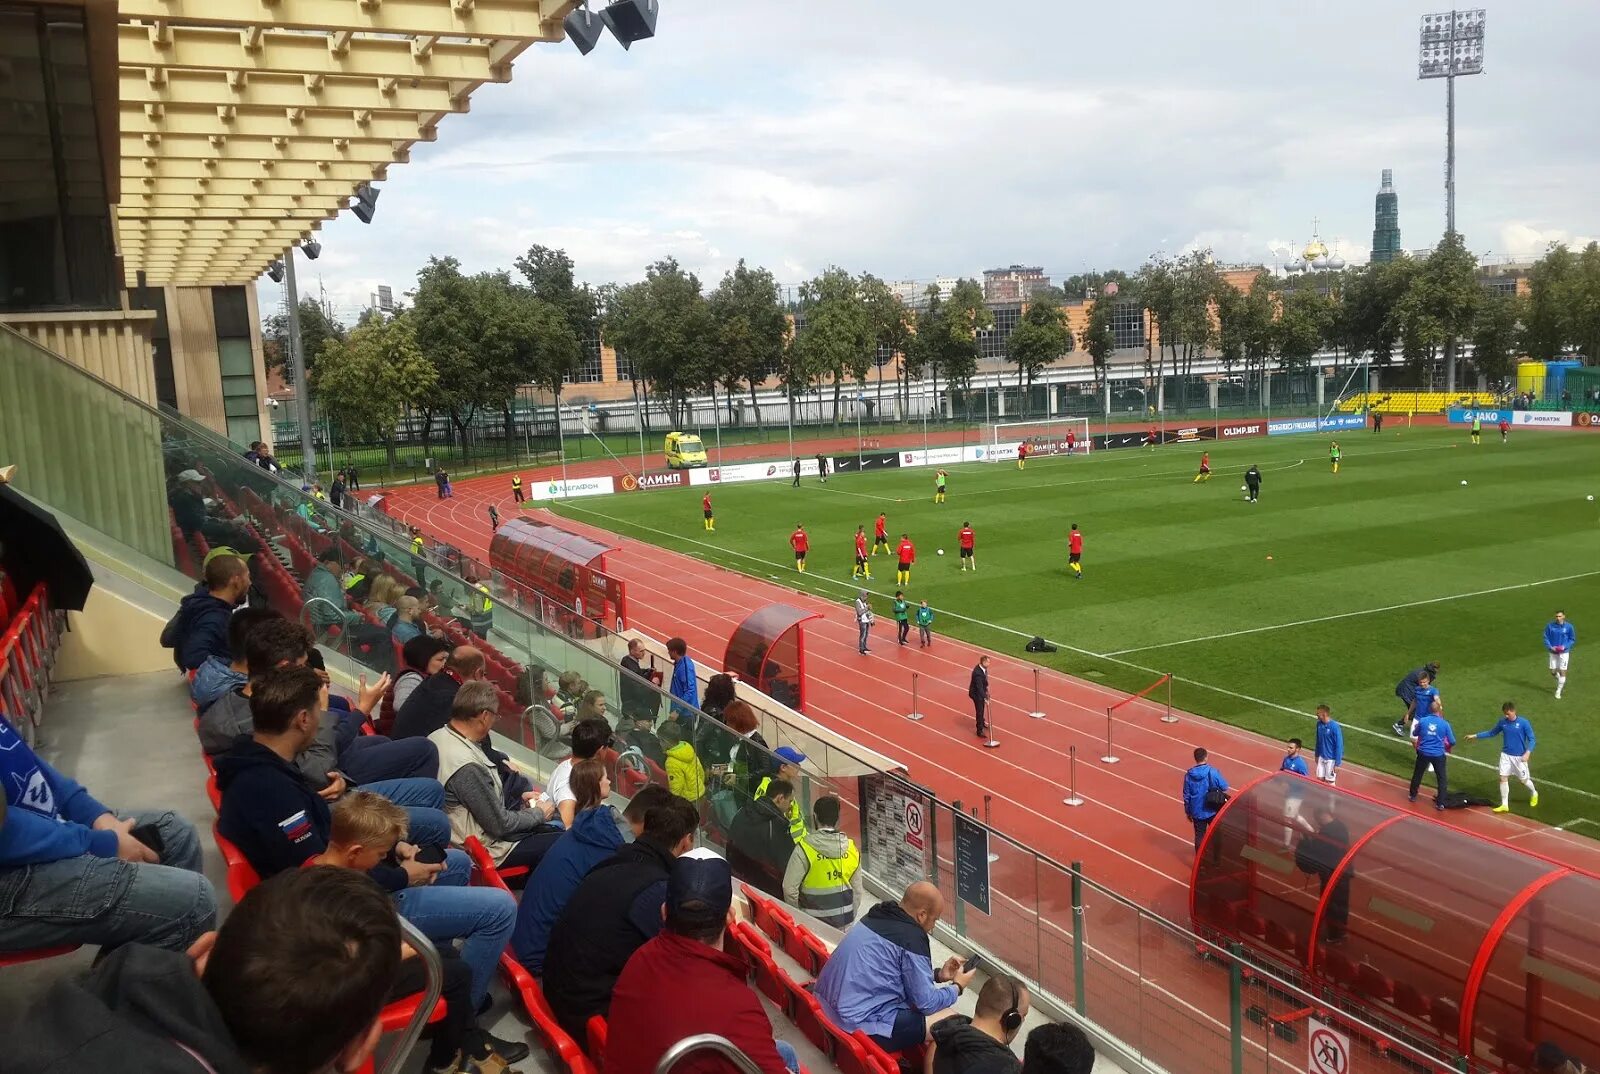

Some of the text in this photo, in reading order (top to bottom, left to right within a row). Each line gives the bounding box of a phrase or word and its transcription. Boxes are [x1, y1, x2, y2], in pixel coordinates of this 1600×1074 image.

[1476, 412, 1498, 422] JAKO
[1223, 425, 1260, 436] OLIMP.BET
[637, 473, 681, 487] ОЛИМП
